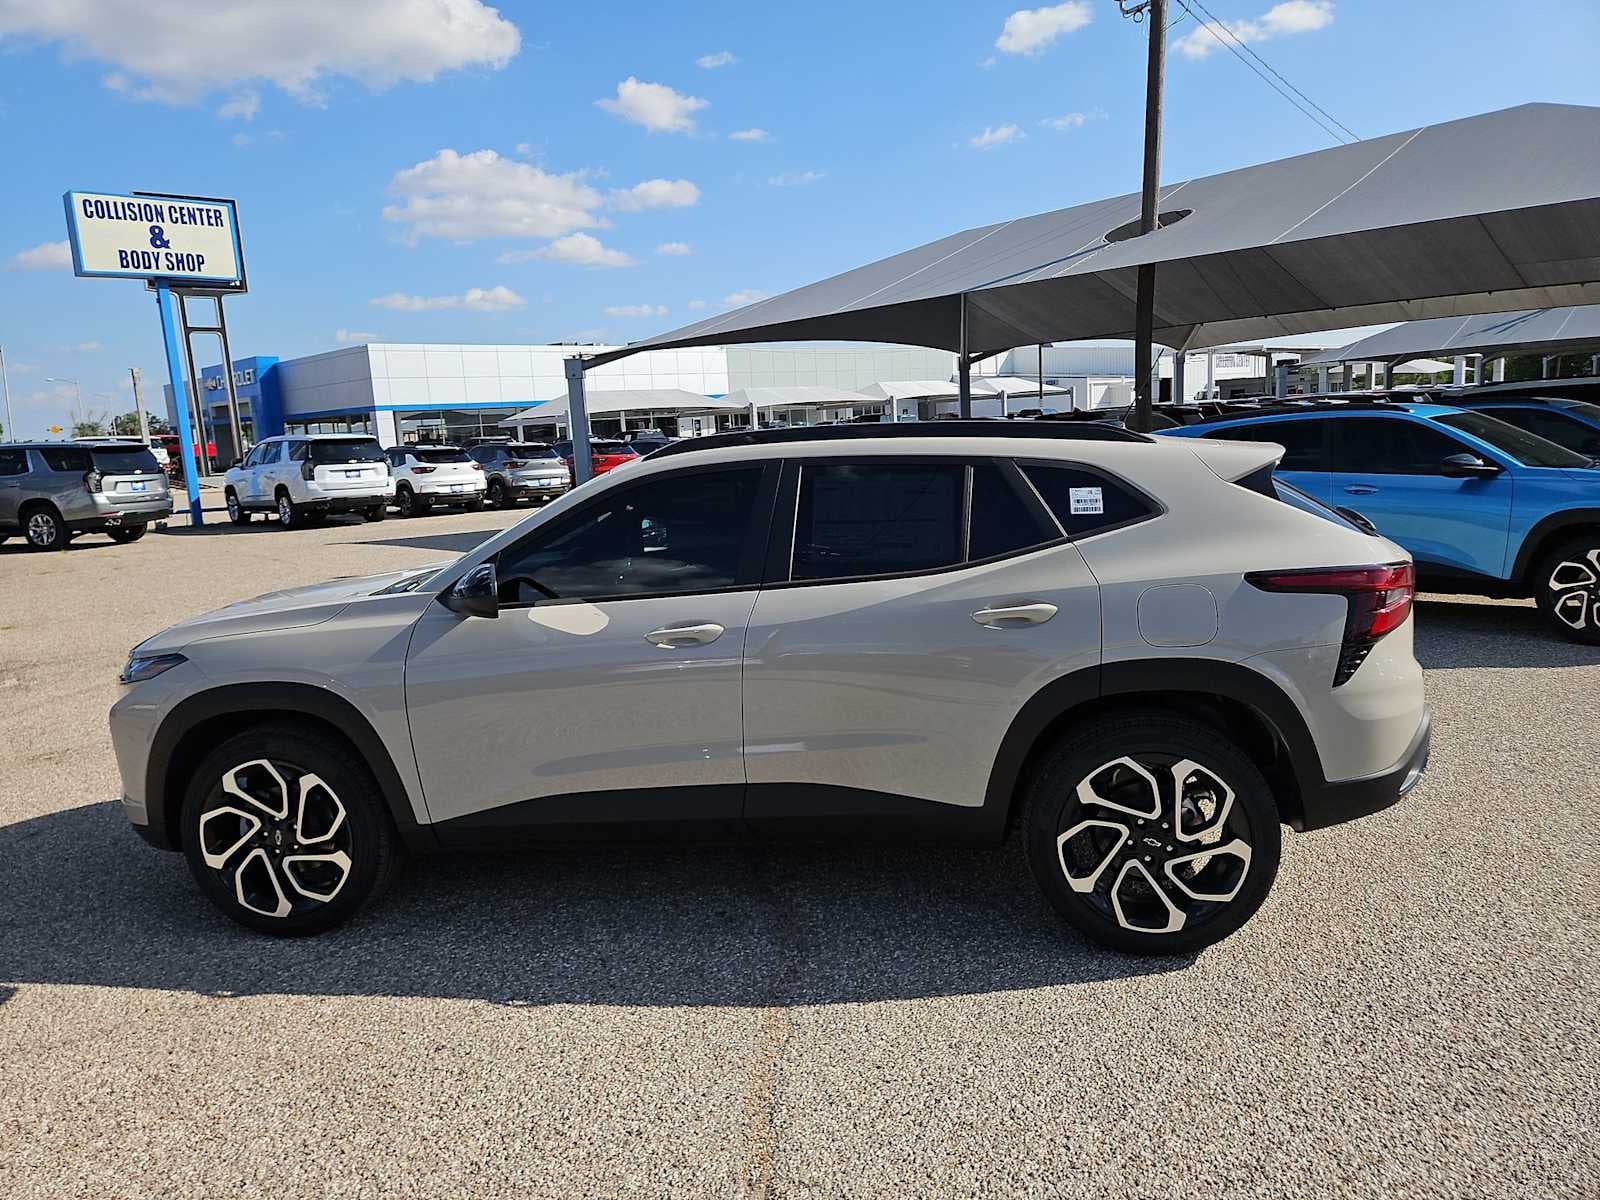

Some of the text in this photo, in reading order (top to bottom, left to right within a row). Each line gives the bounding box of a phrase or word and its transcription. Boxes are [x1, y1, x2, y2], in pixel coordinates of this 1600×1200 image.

[82, 198, 224, 227] COLLISION CENTER
[148, 225, 171, 249] &
[118, 249, 205, 272] BODY SHOP
